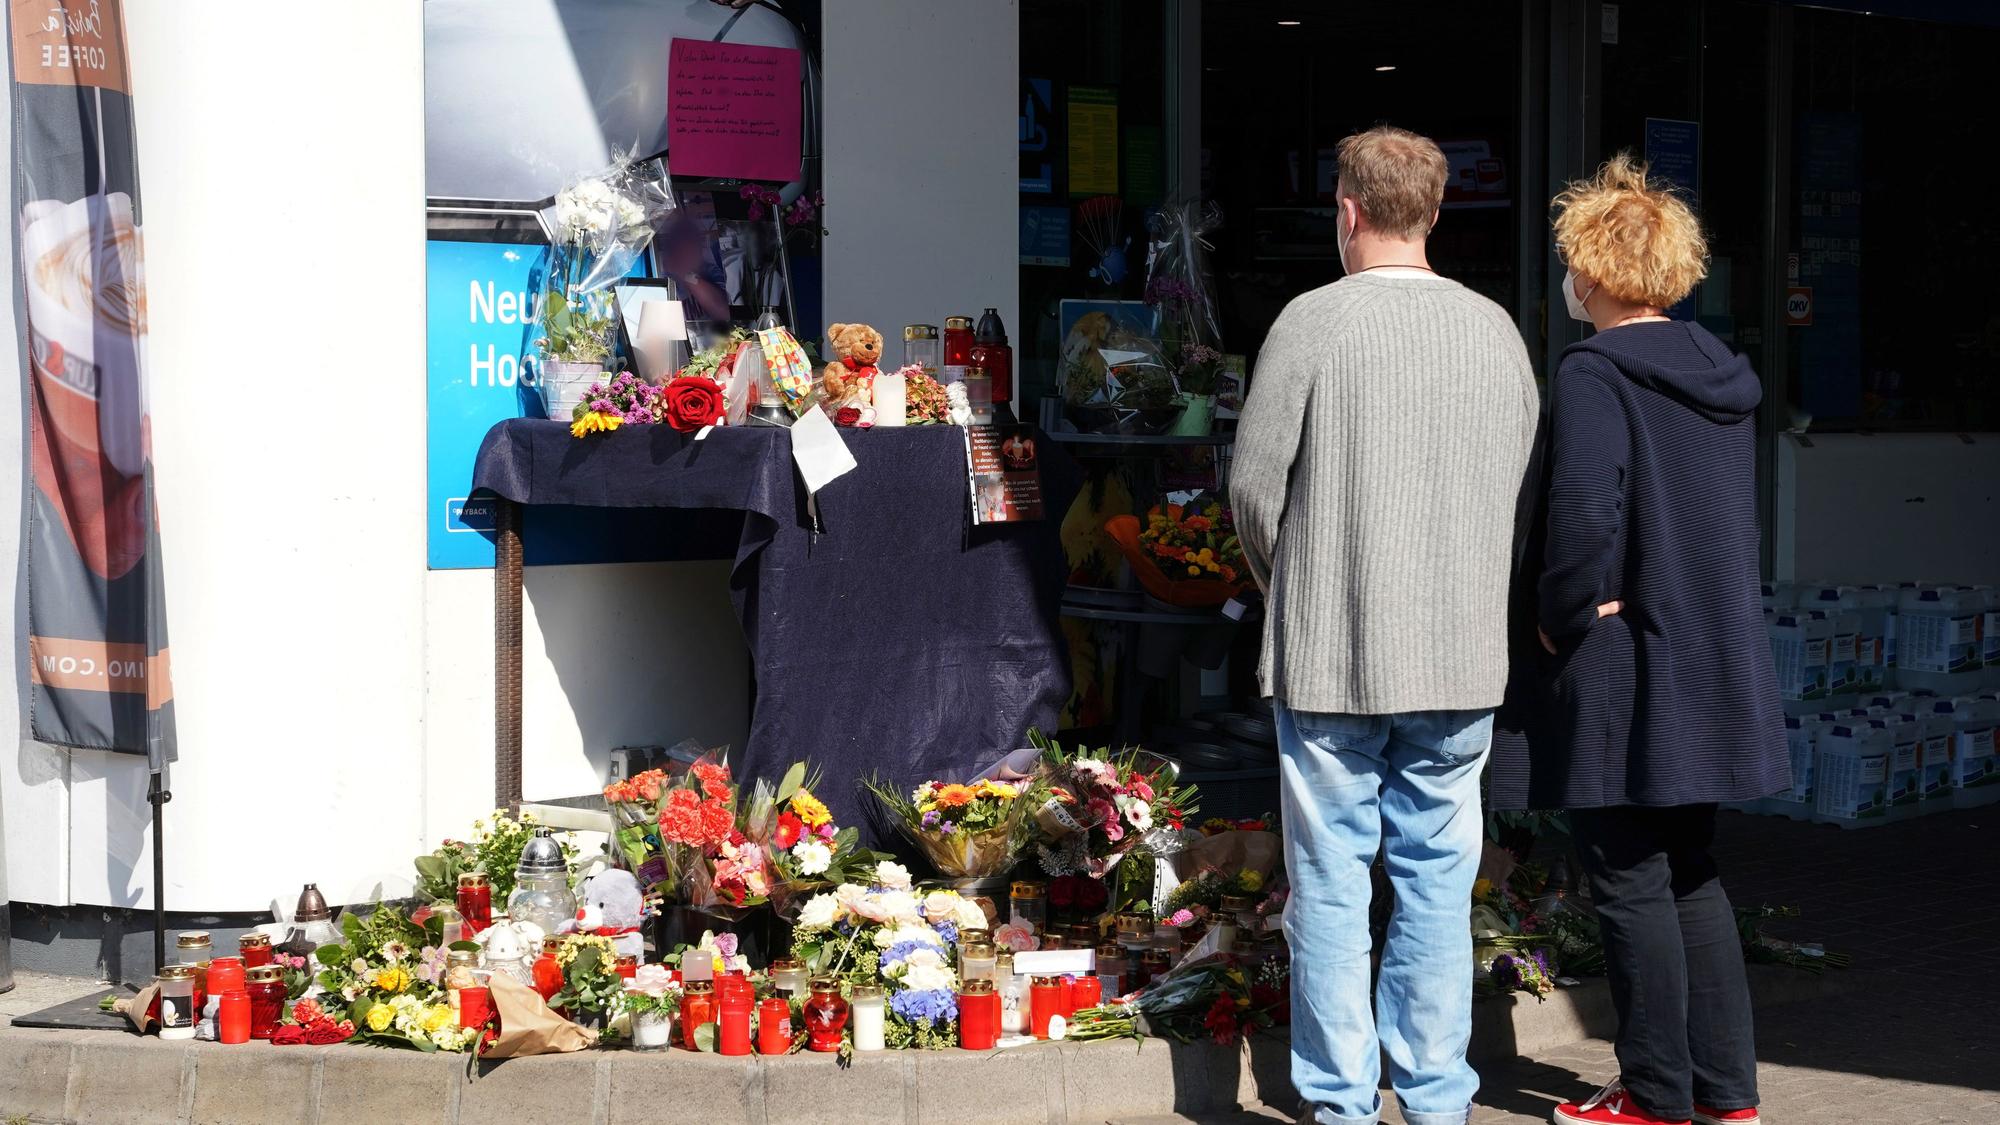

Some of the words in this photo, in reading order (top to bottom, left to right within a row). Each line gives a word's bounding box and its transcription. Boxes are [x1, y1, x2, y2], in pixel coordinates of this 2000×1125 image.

[470, 280, 538, 324] Neu
[1789, 300, 1808, 312] DKV
[470, 343, 544, 387] Hoc
[456, 508, 487, 516] PAYBACK
